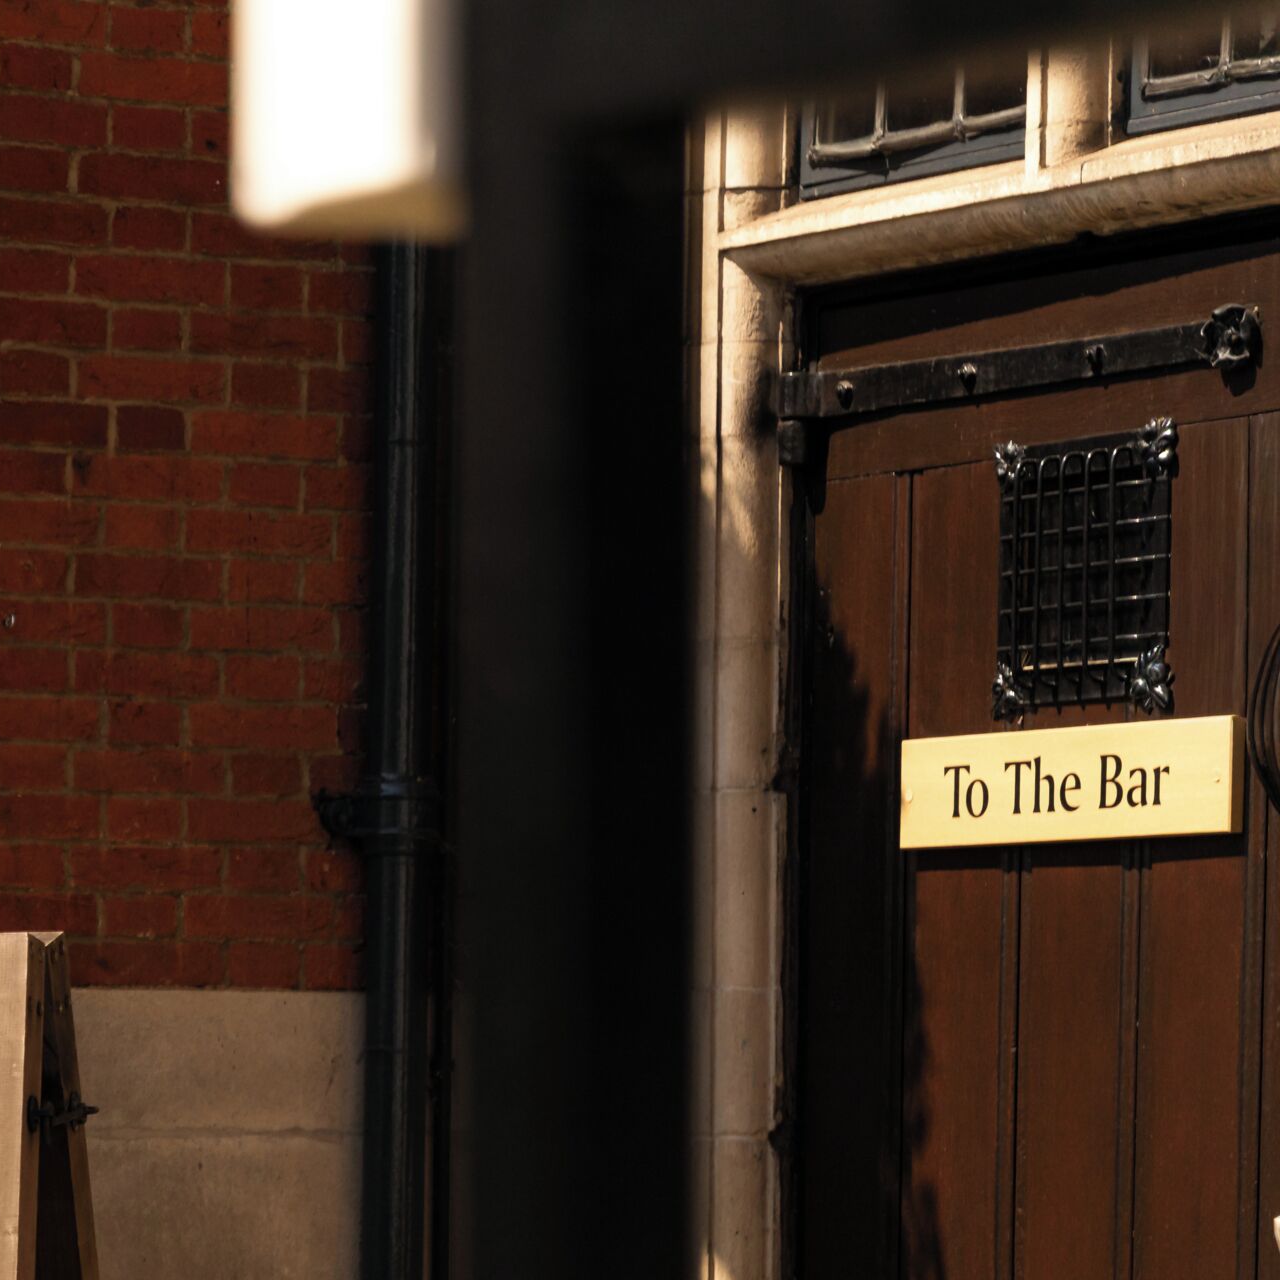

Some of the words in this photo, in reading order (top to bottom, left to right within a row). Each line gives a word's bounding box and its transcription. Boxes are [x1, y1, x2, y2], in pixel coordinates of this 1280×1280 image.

[944, 765, 989, 818] To
[1004, 756, 1082, 814] The
[1099, 754, 1170, 809] Bar
